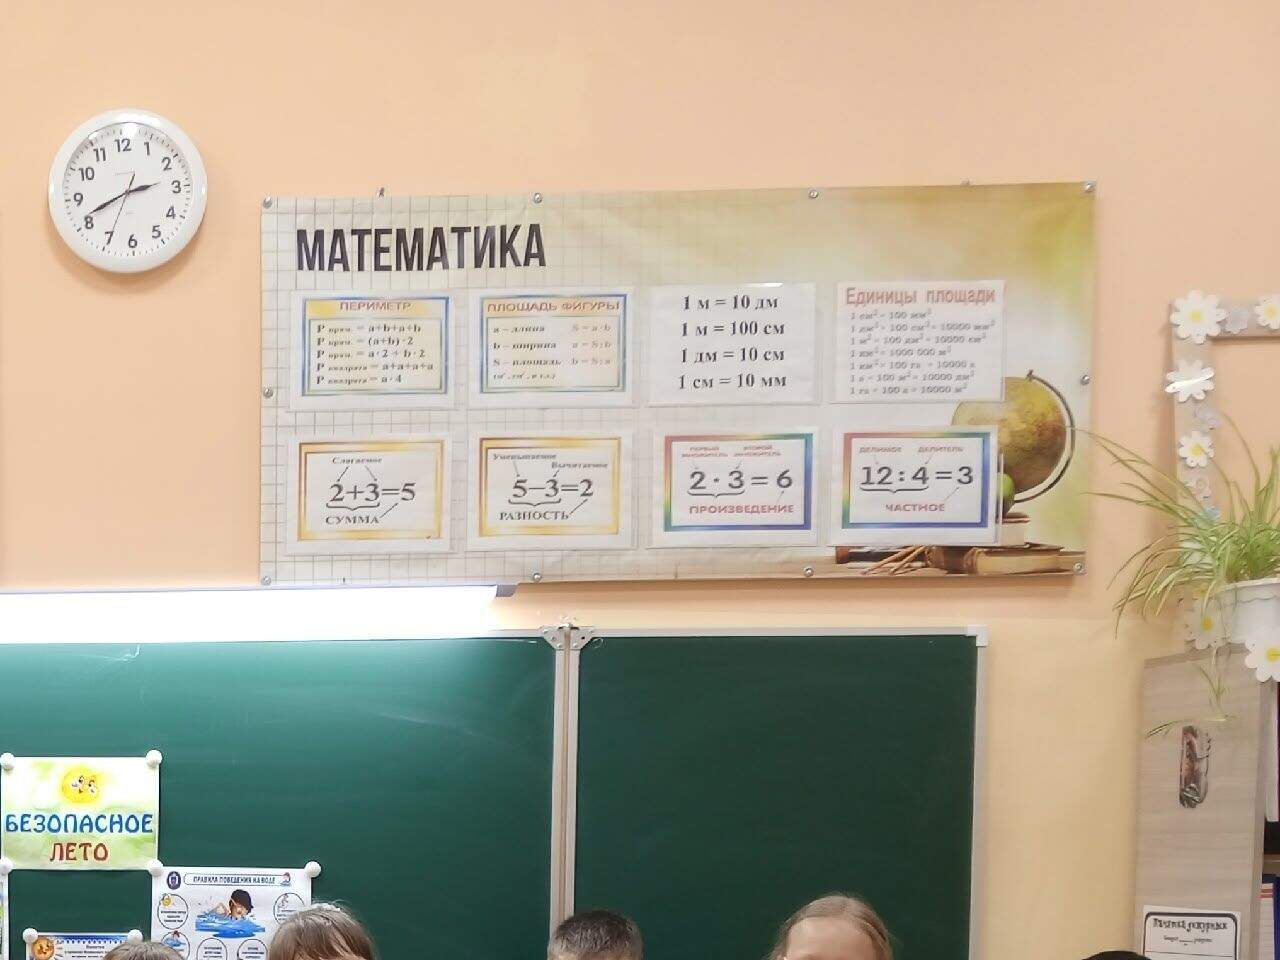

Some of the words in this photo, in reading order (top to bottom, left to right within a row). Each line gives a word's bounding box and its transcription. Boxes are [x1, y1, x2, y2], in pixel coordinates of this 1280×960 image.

[115, 138, 131, 152] 12
[144, 142, 150, 156] 1
[93, 147, 106, 162] 11
[162, 157, 171, 170] 2
[79, 166, 94, 181] 10
[172, 180, 181, 194] 3
[74, 193, 83, 206] 9
[166, 206, 176, 219] 4
[84, 215, 94, 229] 8
[105, 231, 113, 245] 7
[152, 225, 161, 239] 5
[129, 234, 137, 248] 6
[297, 224, 546, 271] МАТЕМАТИКА
[684, 296, 690, 310] 1
[698, 300, 710, 309] м
[733, 295, 750, 309] 10
[755, 298, 778, 310] дм
[846, 287, 917, 306] Единицы
[927, 289, 995, 305] площади
[340, 302, 412, 311] ПЕРИМЕТР
[488, 302, 558, 312] ПЛОЩАДЬ
[562, 301, 620, 311] ФИГУРЫ
[682, 323, 688, 336] 1
[696, 326, 708, 336] м
[731, 321, 758, 335] 100
[763, 324, 785, 334] см
[681, 348, 687, 362] 1
[694, 352, 718, 363] дм
[740, 347, 758, 361] 10
[763, 350, 785, 361] см
[680, 375, 685, 389] 1
[693, 378, 714, 388] см
[738, 374, 755, 387] 10
[761, 377, 786, 387] мм
[330, 482, 416, 502] 2+3=5
[500, 511, 569, 520] РАЗНОСТЬ
[689, 505, 794, 514] ПРОИЗВЕДЕНИЕ
[326, 516, 379, 524] СУММА
[5, 814, 153, 833] БЕЗОПАСНОЕ
[50, 843, 108, 861] ЛЕТО
